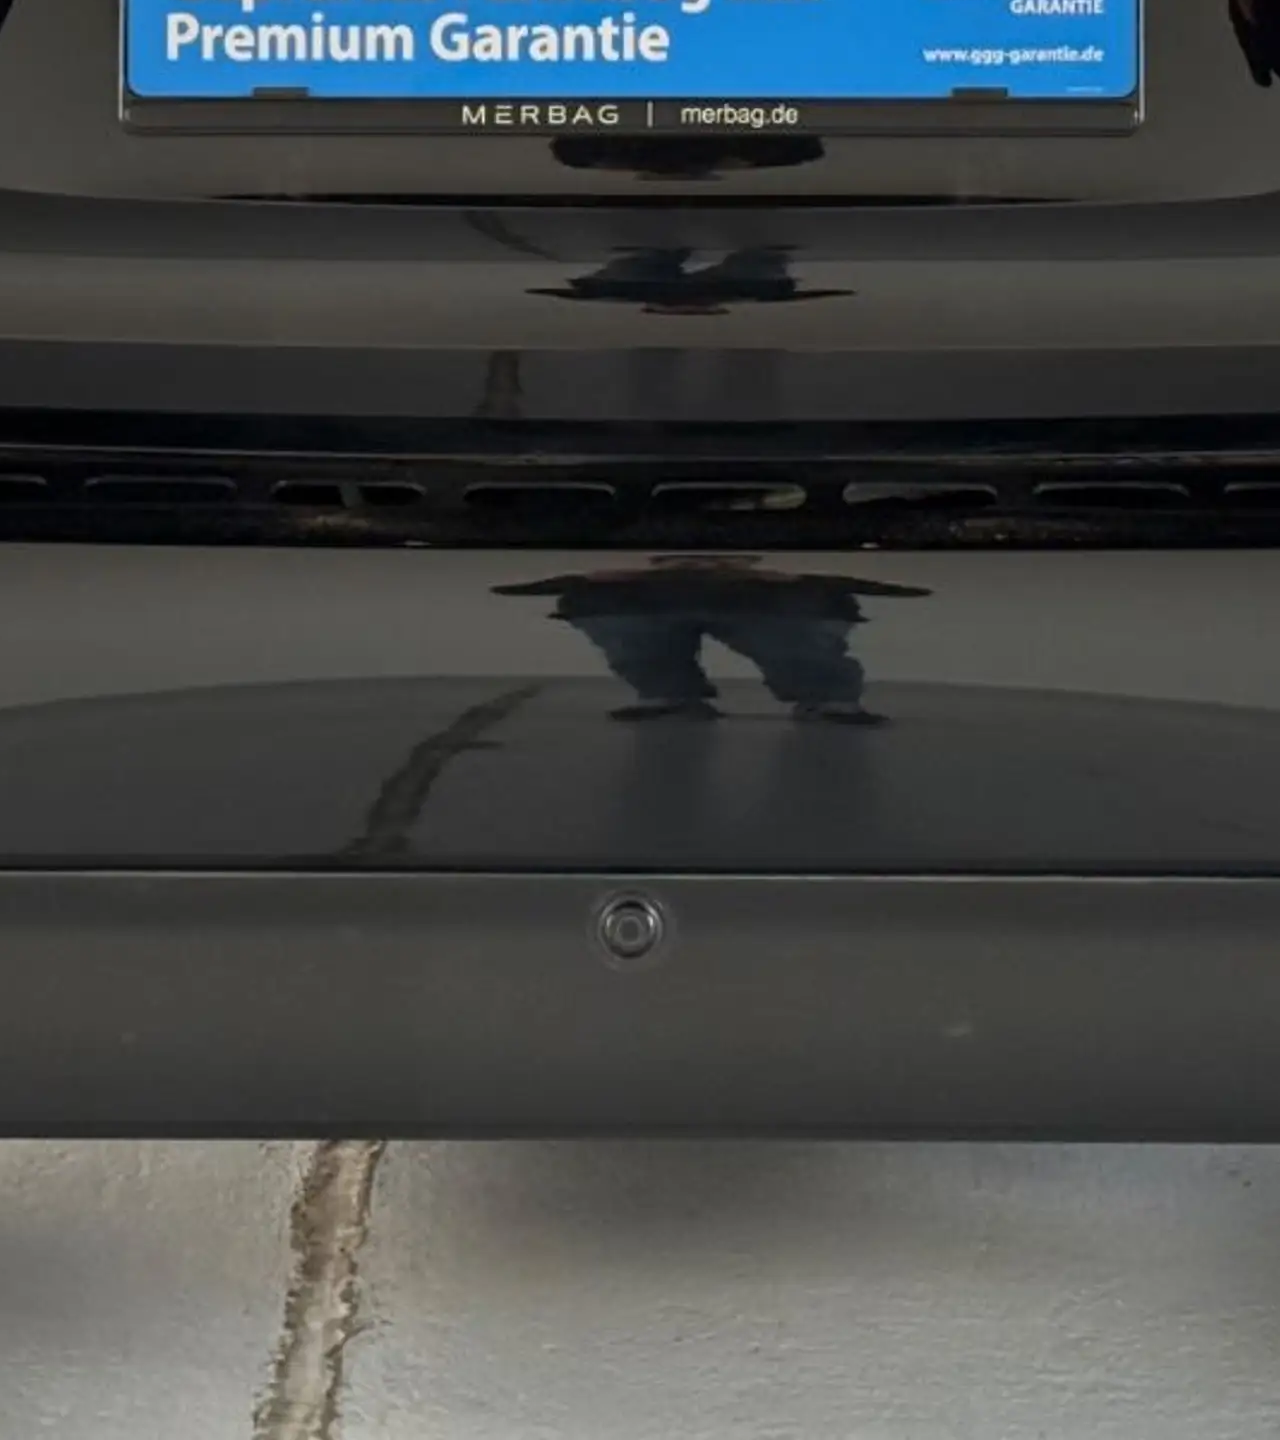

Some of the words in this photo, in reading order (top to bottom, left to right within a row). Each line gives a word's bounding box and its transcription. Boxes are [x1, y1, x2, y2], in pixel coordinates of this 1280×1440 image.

[166, 12, 415, 62] Premium
[429, 11, 671, 62] Garantie
[922, 45, 1104, 65] www.ggg-garantie.de
[461, 104, 620, 125] MERBAG
[681, 103, 800, 129] merbag.de
